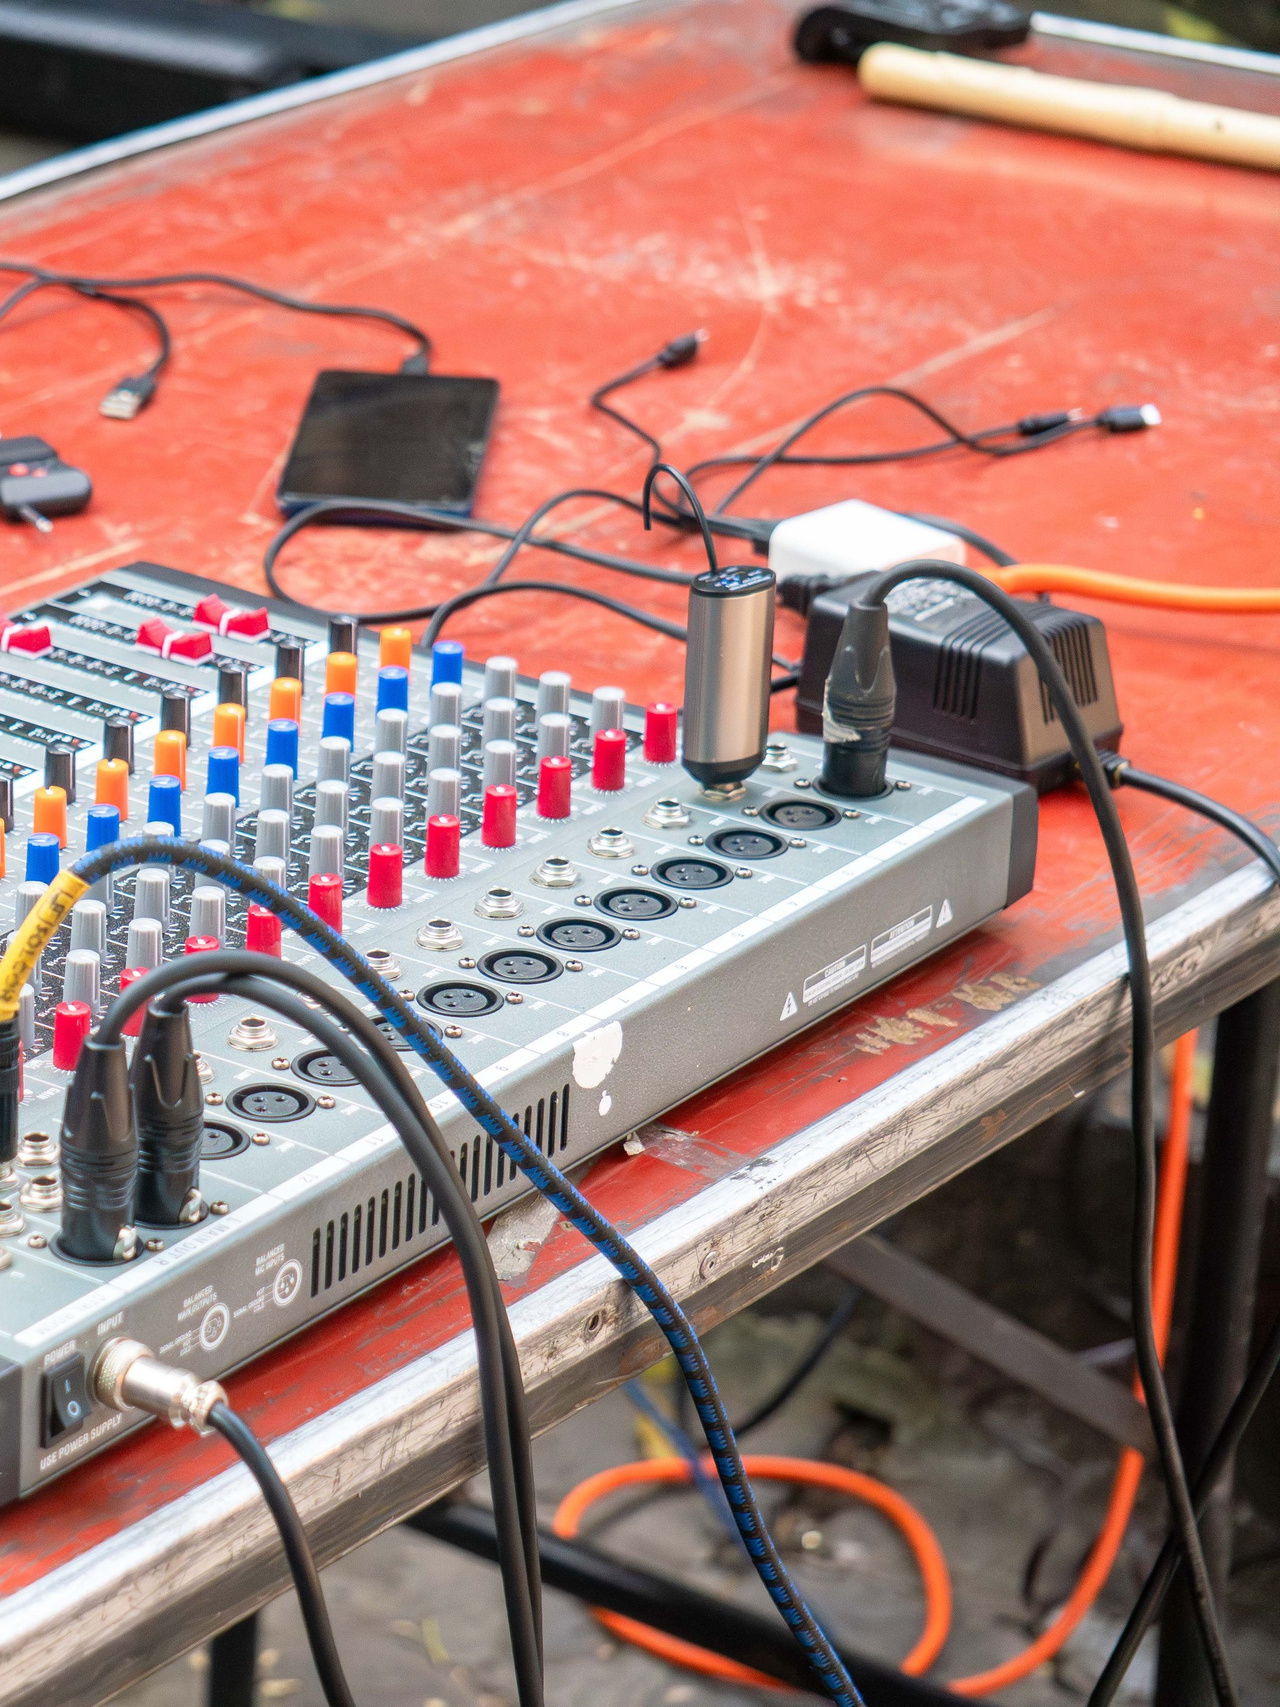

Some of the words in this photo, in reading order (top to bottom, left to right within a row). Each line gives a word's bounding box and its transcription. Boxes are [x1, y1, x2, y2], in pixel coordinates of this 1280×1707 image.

[191, 1220, 231, 1245] MAIN
[169, 1241, 198, 1260] OUT
[255, 1243, 285, 1266] BALANCED
[183, 1284, 214, 1308] BALANCED
[97, 1311, 123, 1336] INPUT
[44, 1339, 76, 1367] POWER
[40, 1450, 58, 1470] USE
[58, 1432, 89, 1459] POWER
[90, 1412, 122, 1440] SUPPLY
